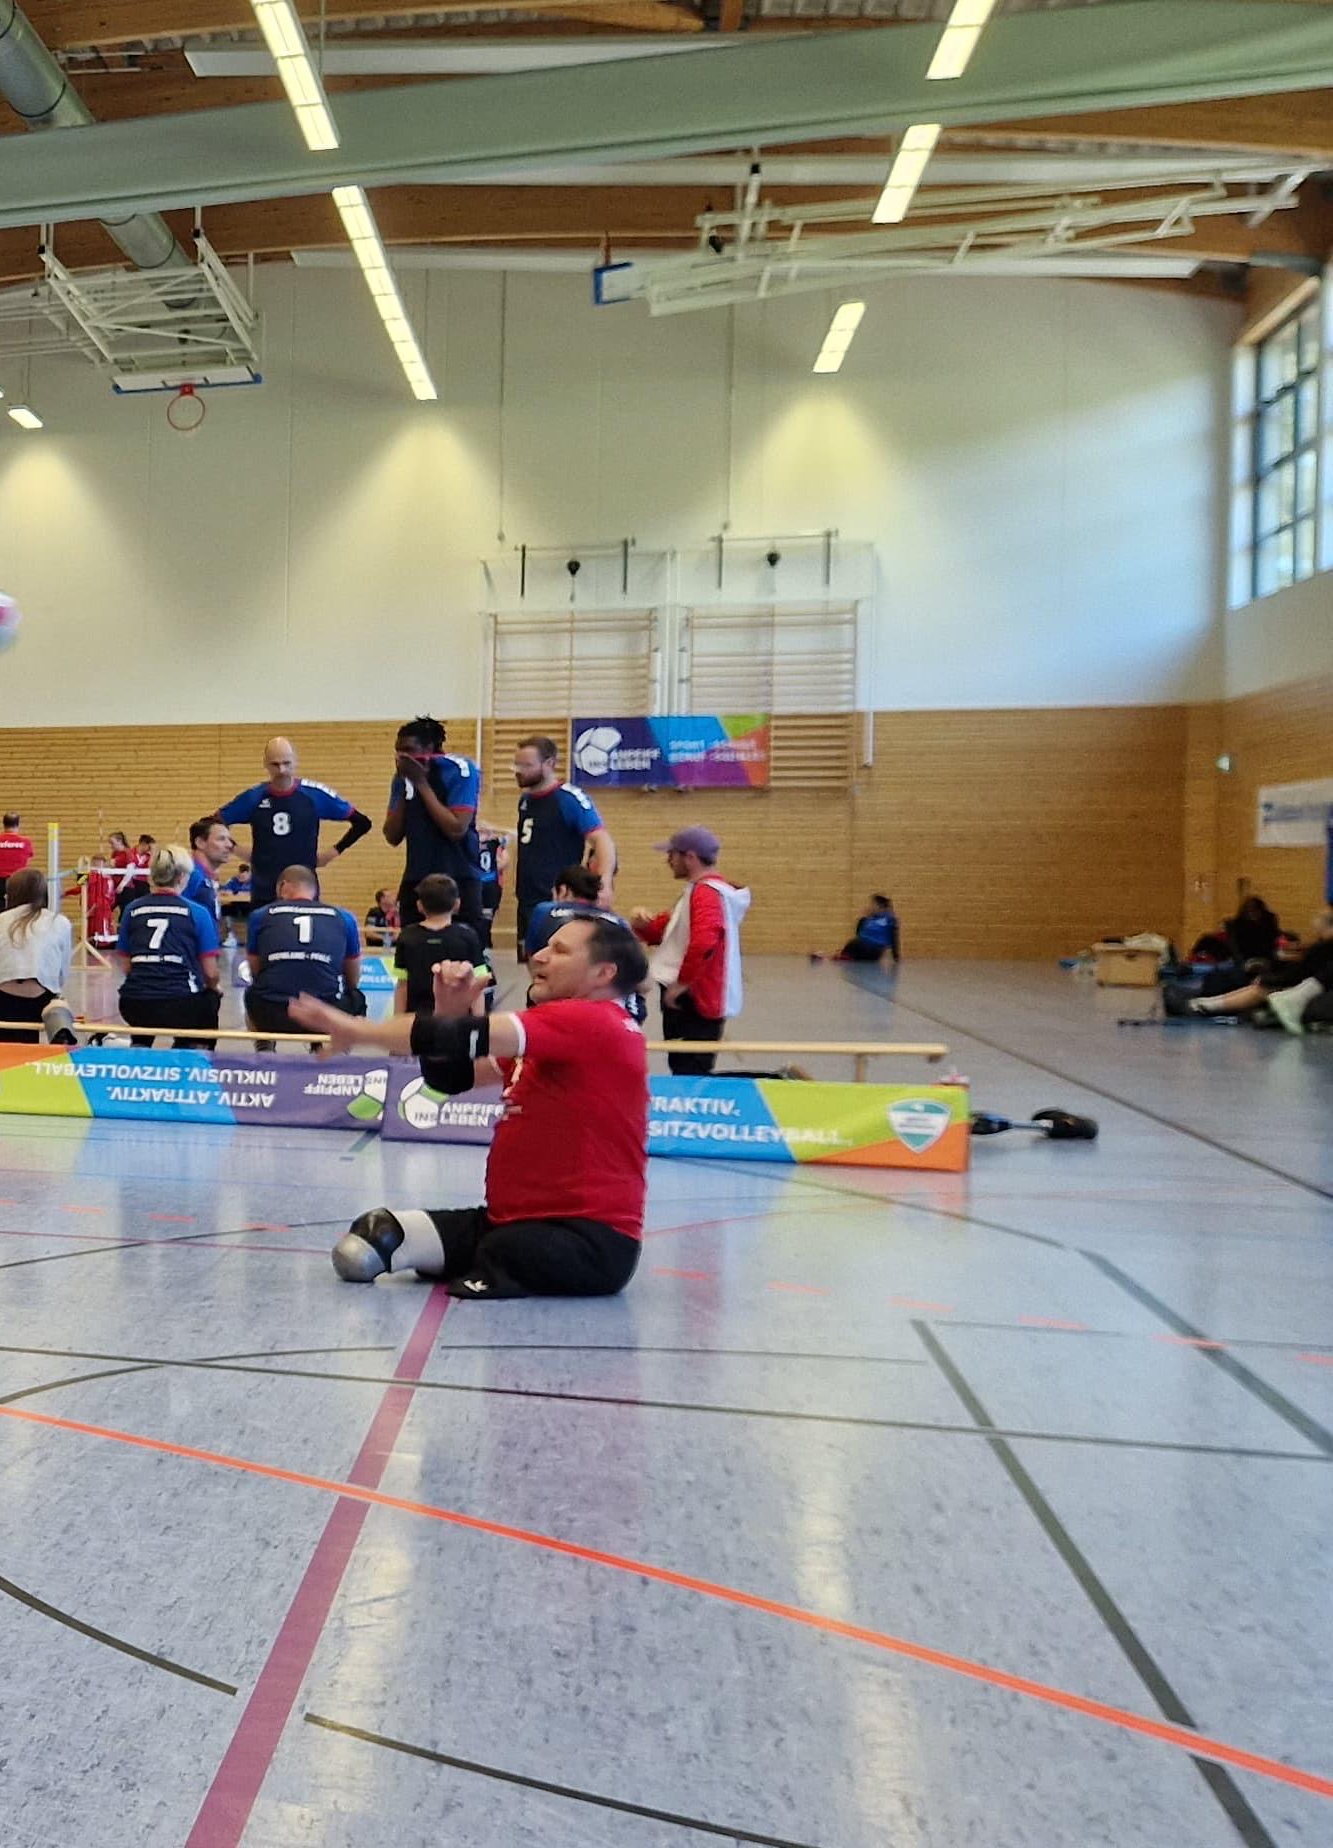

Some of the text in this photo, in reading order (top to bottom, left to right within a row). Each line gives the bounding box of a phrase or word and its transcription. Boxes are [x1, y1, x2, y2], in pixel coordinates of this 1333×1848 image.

[273, 812, 290, 835] 8
[521, 819, 534, 844] 5
[147, 918, 169, 949] 7
[293, 915, 311, 943] 1
[184, 1067, 278, 1086] INKLUSIV.
[107, 1086, 275, 1109] AKTIV. ATTRAKTIV.
[439, 1113, 489, 1127] LEBEN
